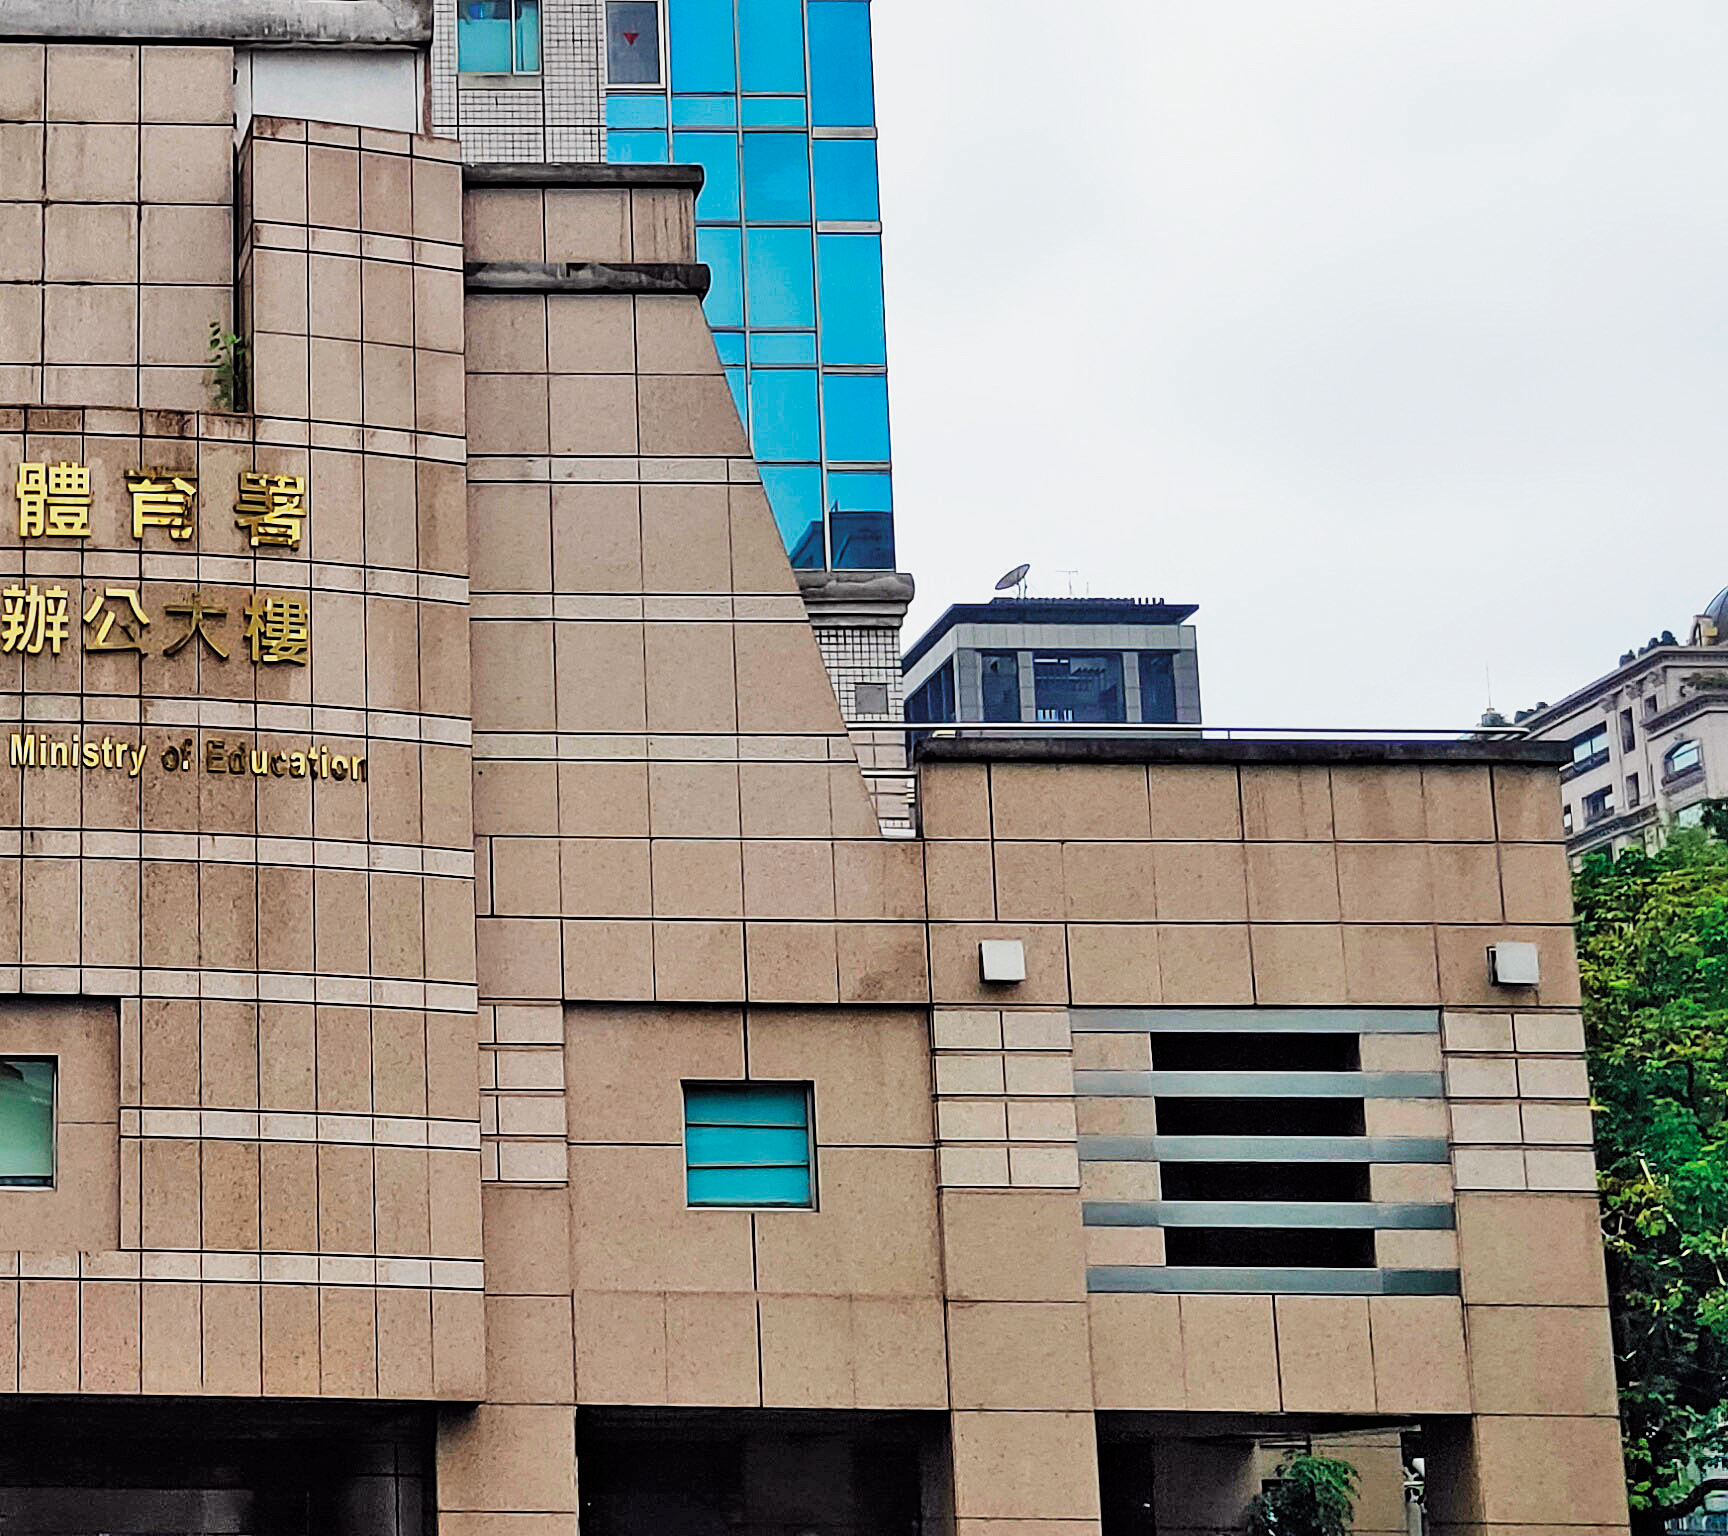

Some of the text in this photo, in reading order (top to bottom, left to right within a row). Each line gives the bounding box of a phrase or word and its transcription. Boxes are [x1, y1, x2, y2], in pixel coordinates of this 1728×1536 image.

[9, 734, 148, 777] Ministry
[161, 738, 193, 772] of
[206, 740, 368, 782] Education
